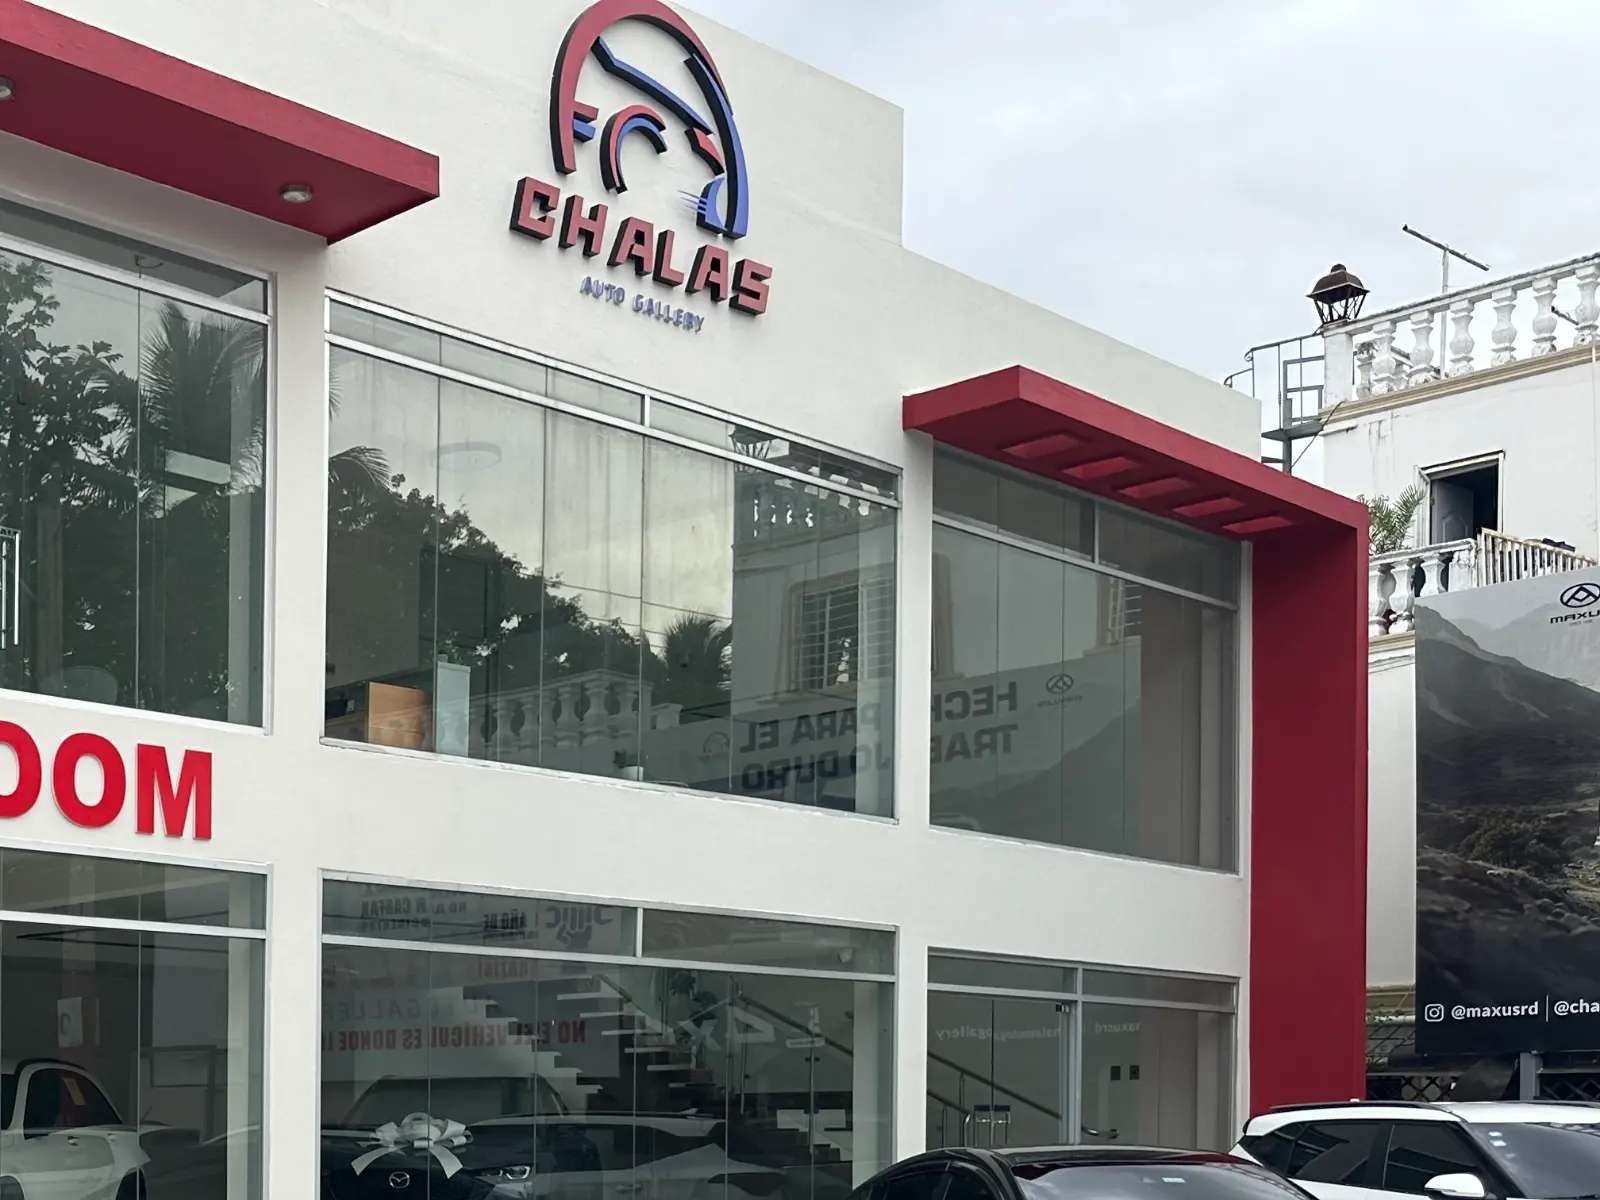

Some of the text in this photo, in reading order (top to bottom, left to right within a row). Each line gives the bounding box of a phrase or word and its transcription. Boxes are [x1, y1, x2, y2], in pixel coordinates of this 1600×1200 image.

[509, 175, 773, 316] CHALAS
[579, 276, 705, 333] AUTO GALLERY
[1451, 1001, 1539, 1020] @maxusrd
